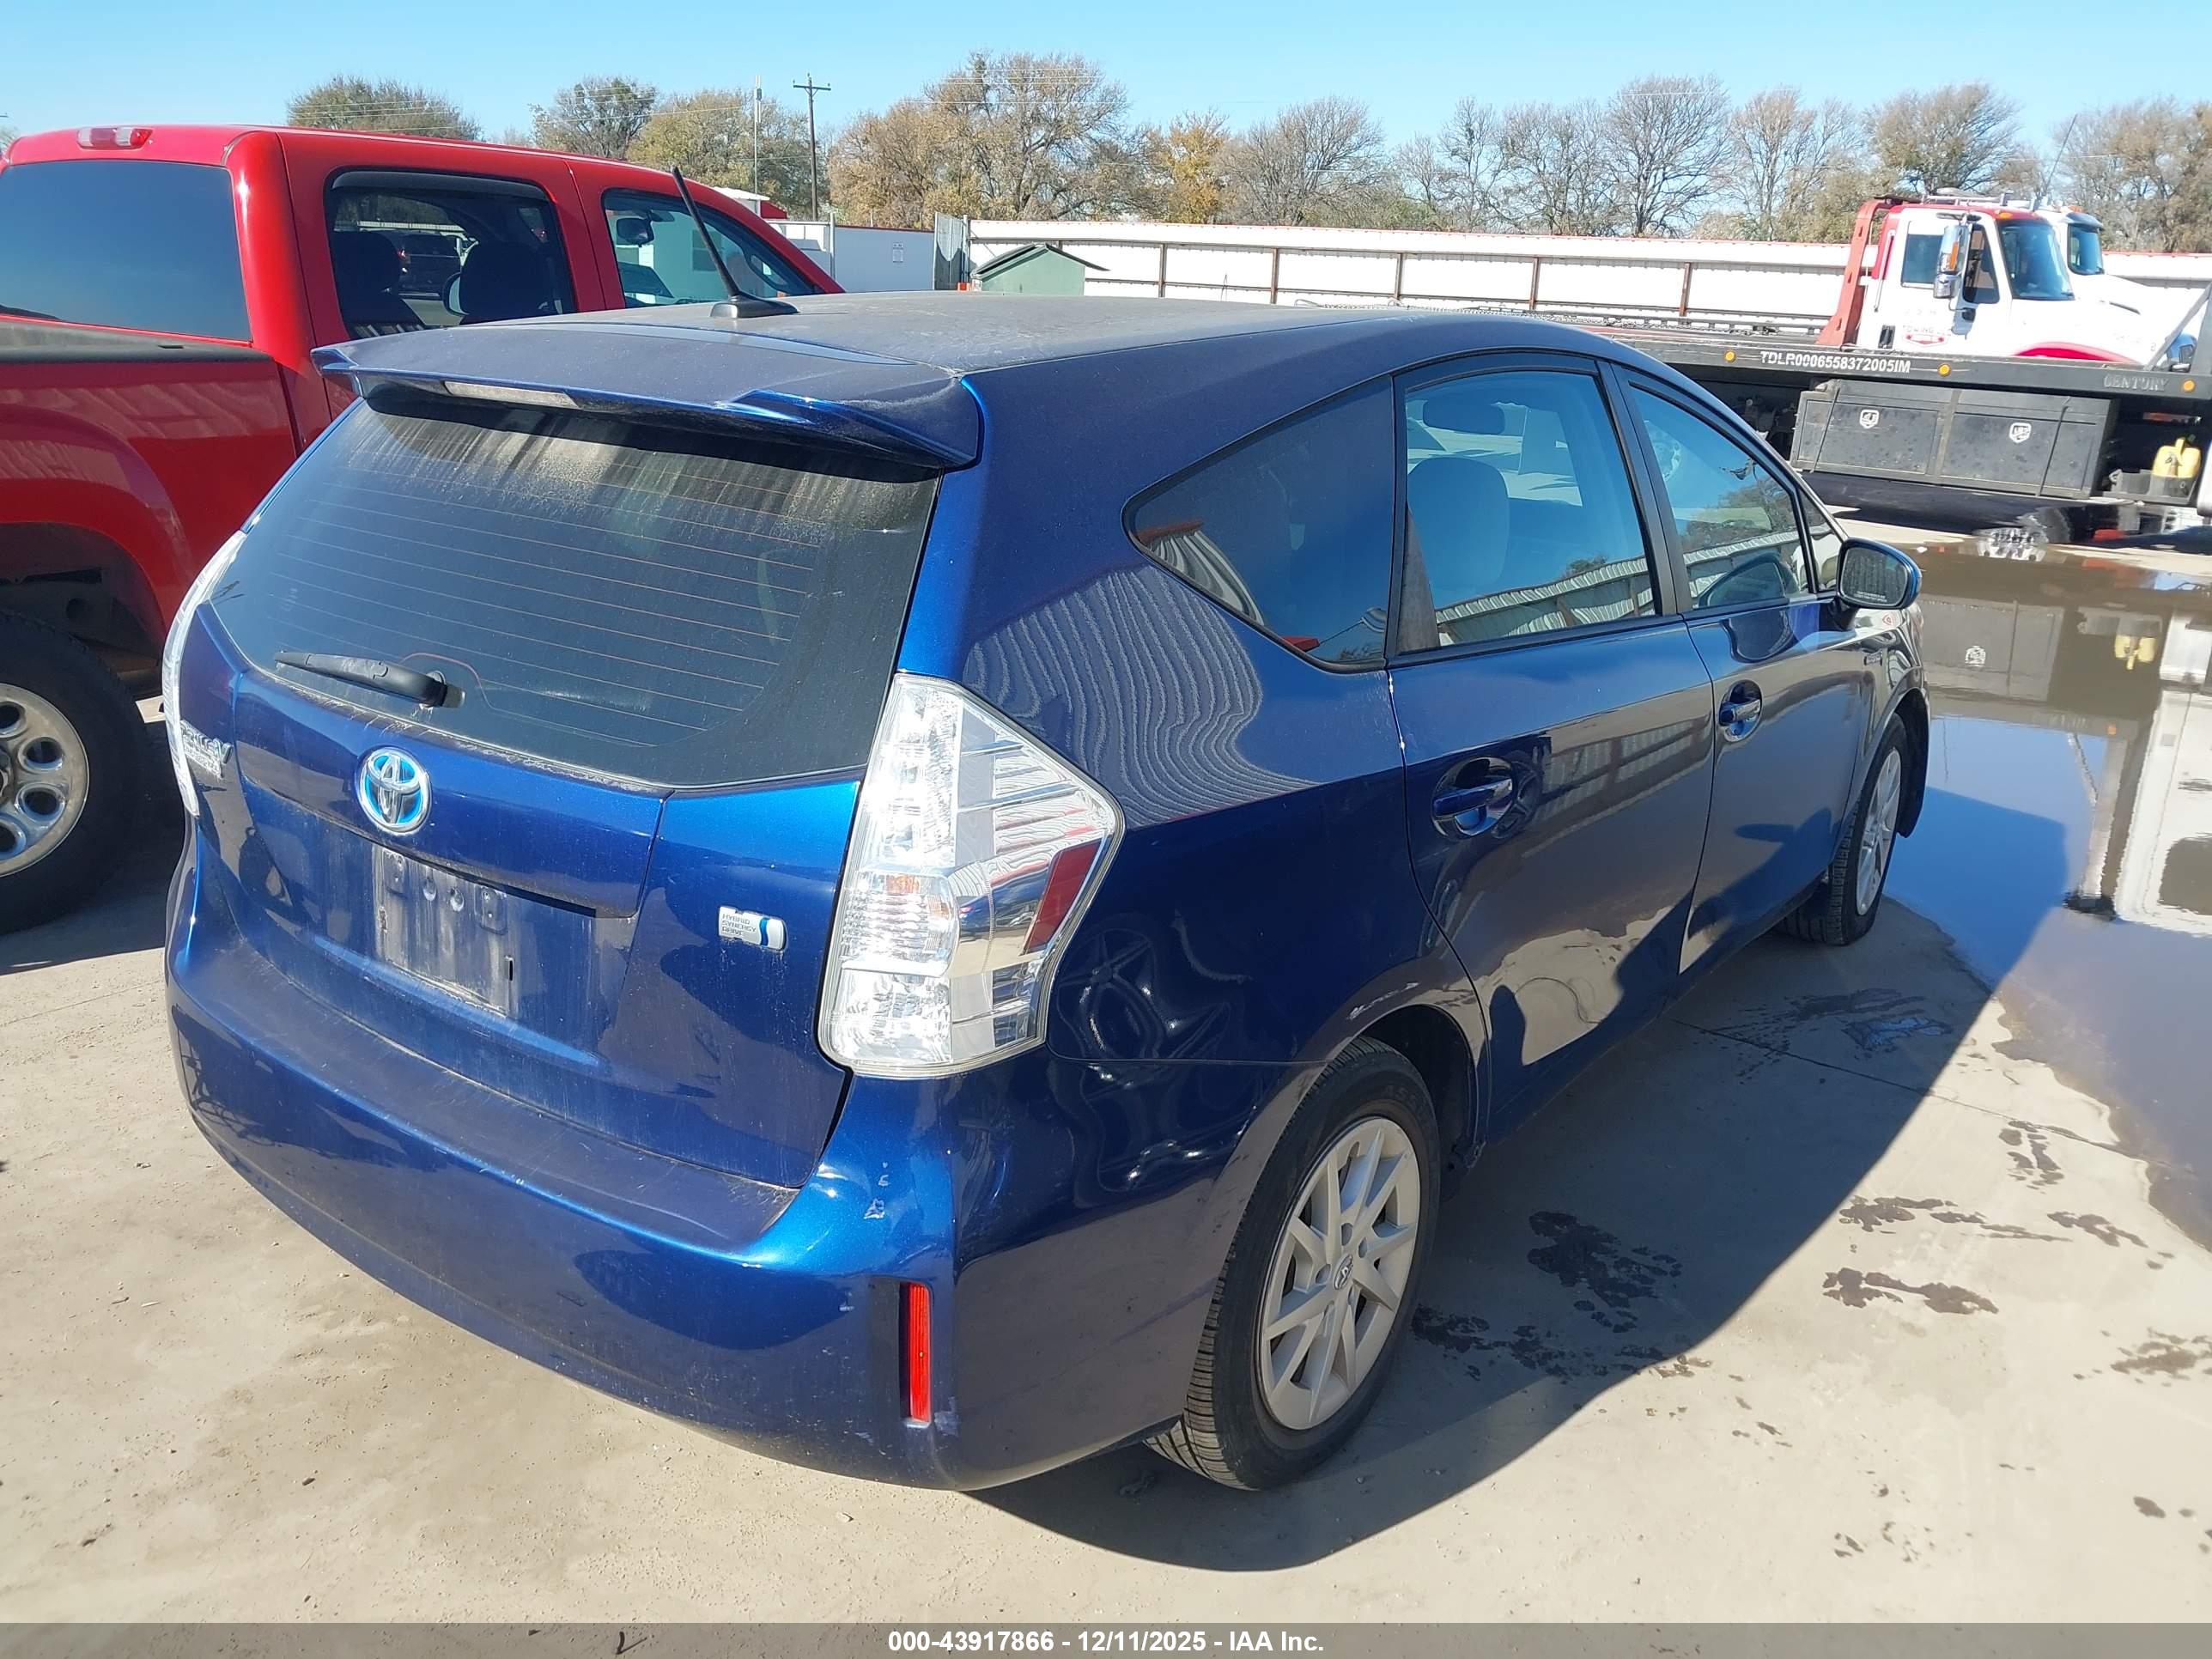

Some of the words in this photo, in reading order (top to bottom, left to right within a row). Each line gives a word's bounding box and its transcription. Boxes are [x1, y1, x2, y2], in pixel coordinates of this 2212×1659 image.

[1760, 350, 1911, 374] TDLR0006558372005IM
[2104, 374, 2169, 392] CENTURY
[721, 920, 757, 933] SYNERGY
[722, 913, 750, 925] HYBRID
